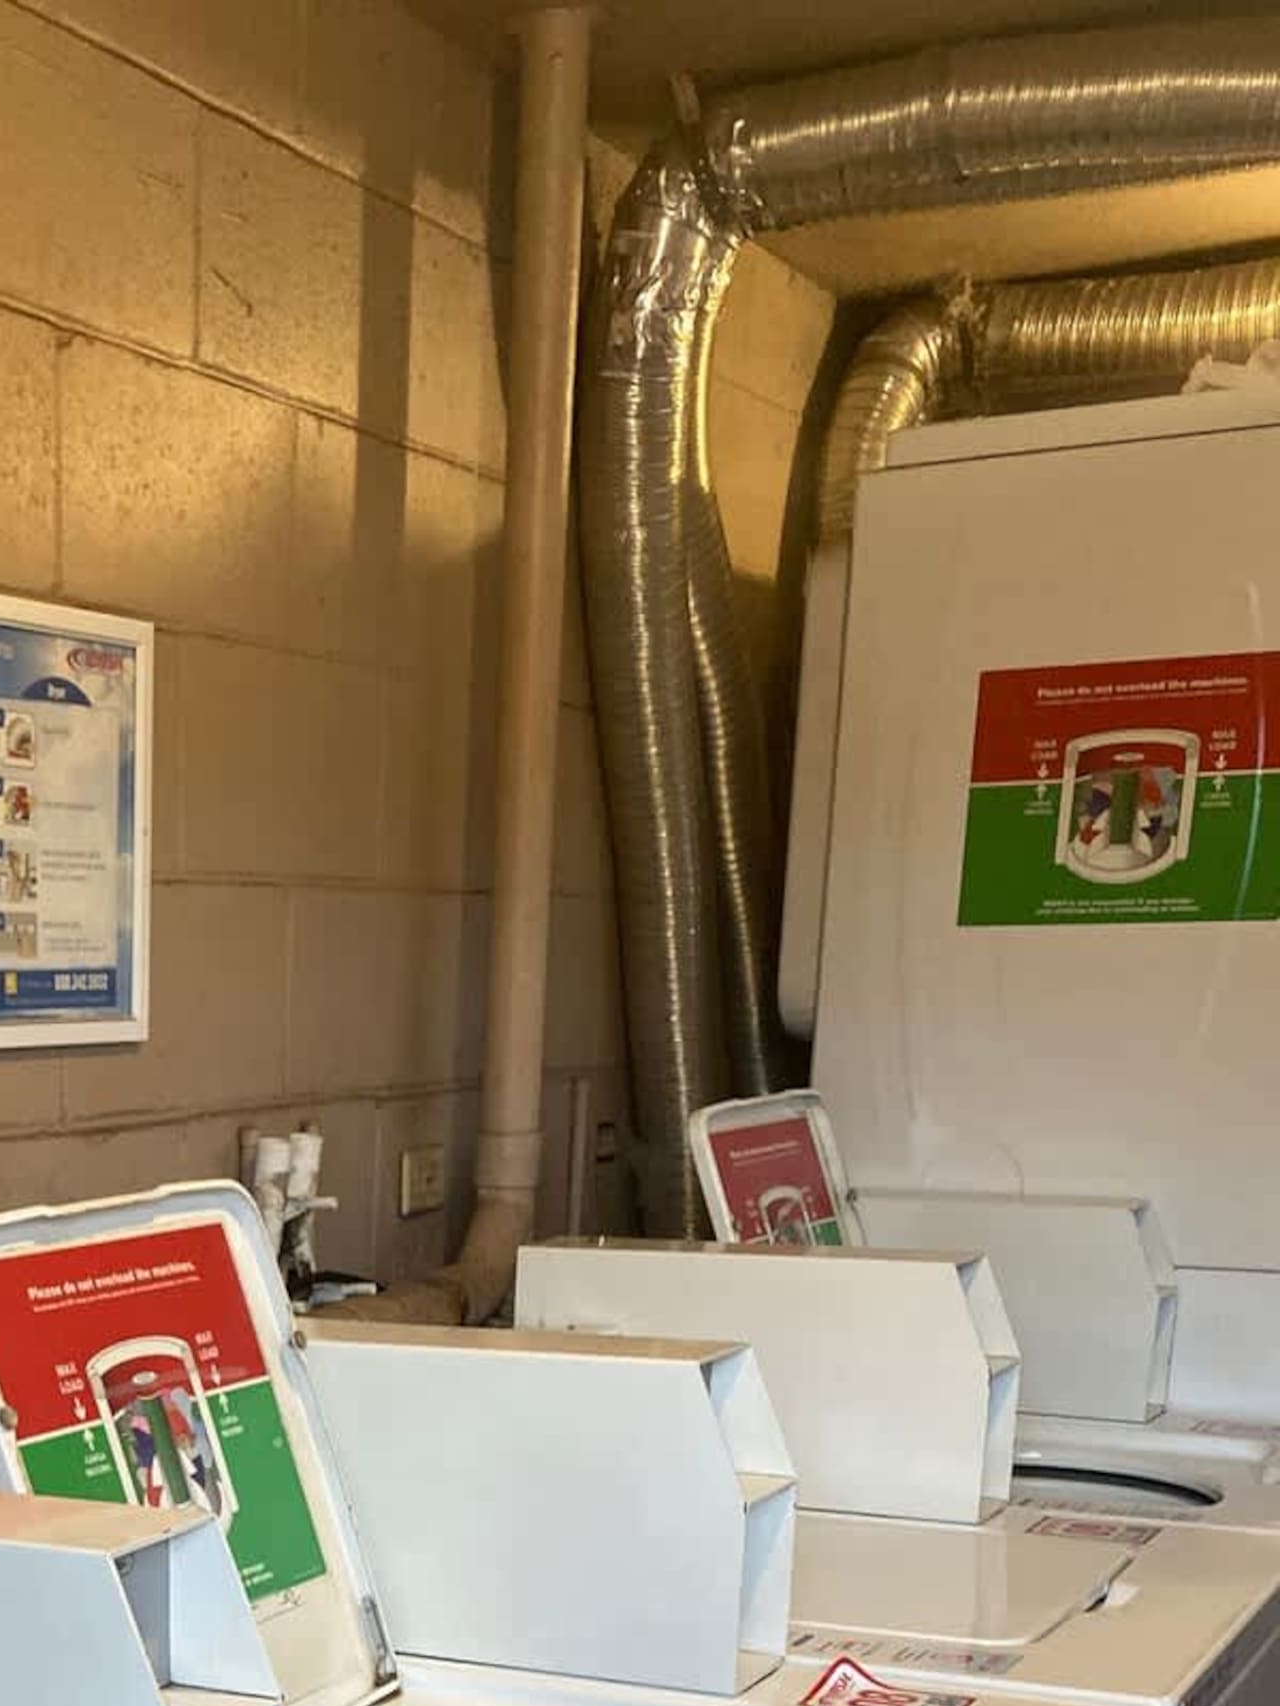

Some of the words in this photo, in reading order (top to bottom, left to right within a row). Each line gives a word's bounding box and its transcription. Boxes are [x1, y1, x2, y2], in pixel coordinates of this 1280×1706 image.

[26, 1286, 63, 1300] Please
[63, 1281, 77, 1295] do
[77, 1277, 95, 1292] not
[95, 1269, 135, 1288] overload
[135, 1267, 151, 1281] the
[56, 1363, 77, 1376] MAX
[59, 1378, 85, 1394] LOAD
